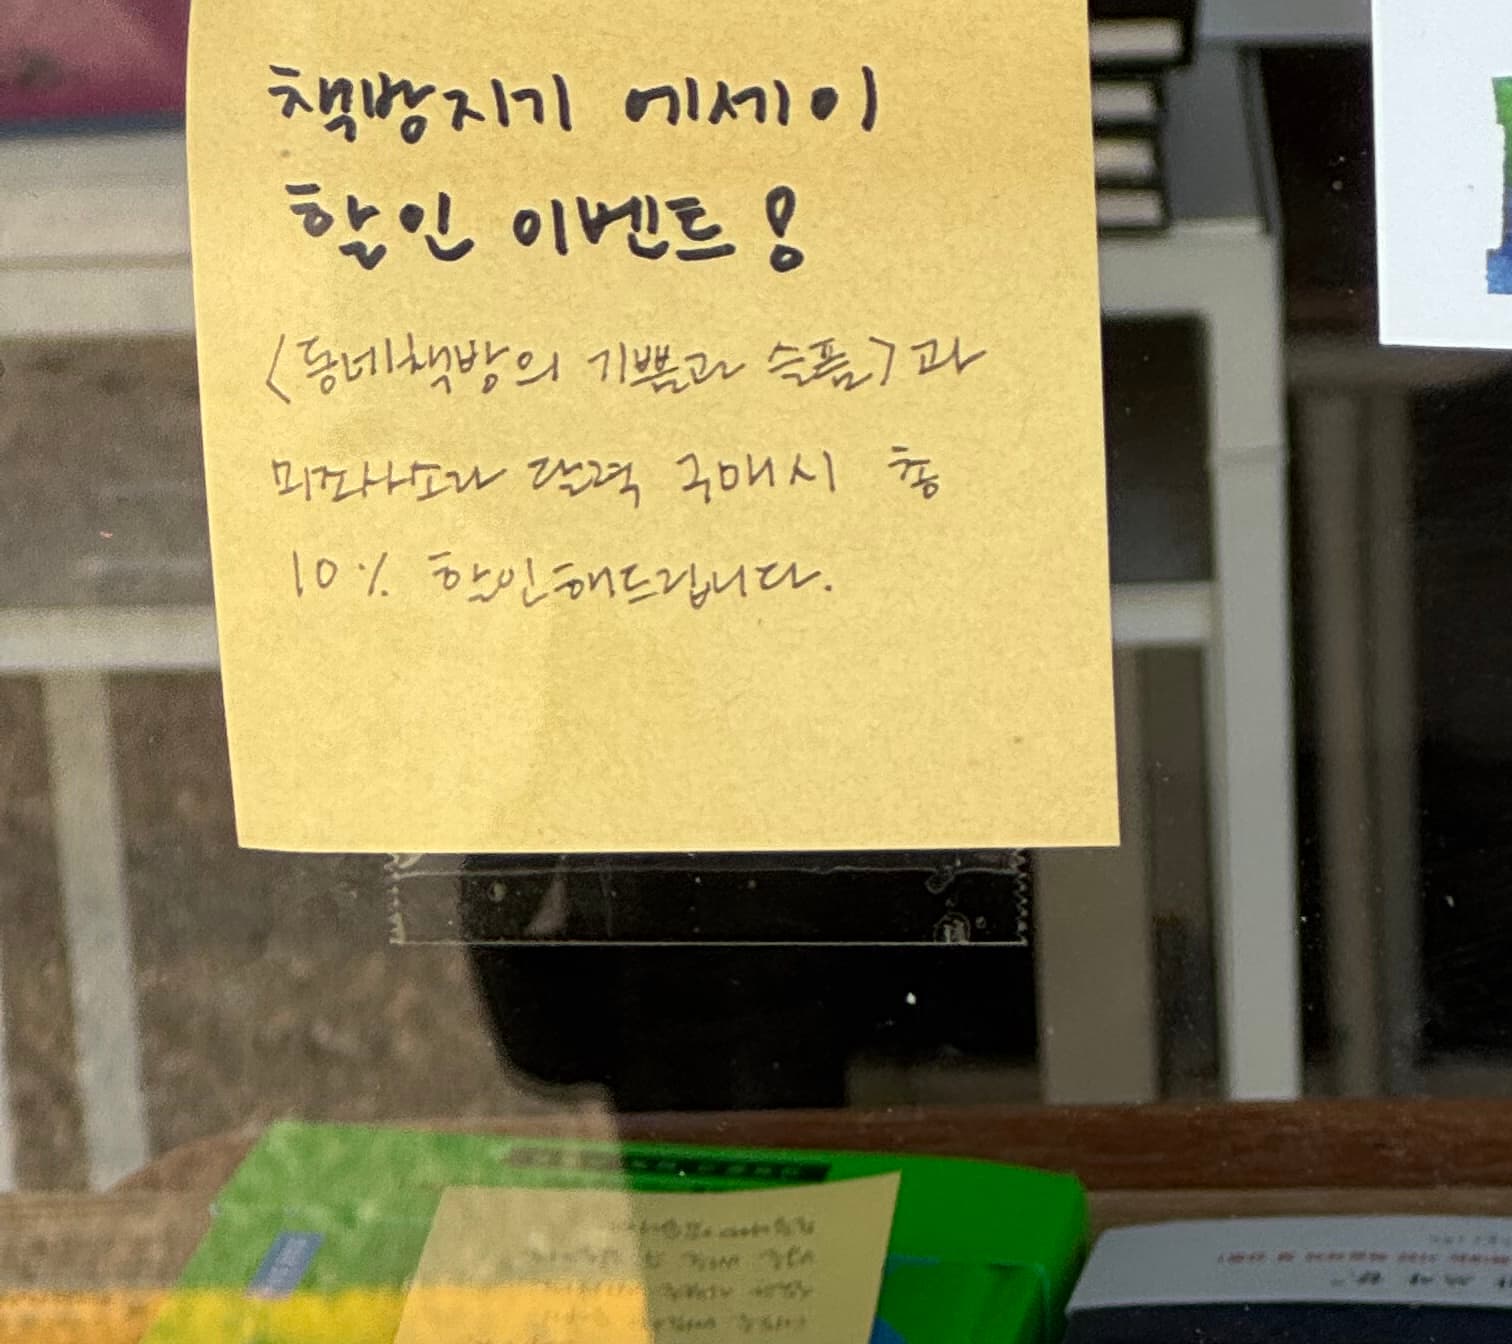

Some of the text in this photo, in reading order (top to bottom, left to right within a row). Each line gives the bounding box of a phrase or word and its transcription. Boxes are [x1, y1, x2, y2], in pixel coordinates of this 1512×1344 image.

[268, 63, 878, 143] 책방지기 에세이
[285, 183, 475, 271] 할인
[587, 341, 746, 395] 기쁨과
[528, 455, 641, 509] 달력
